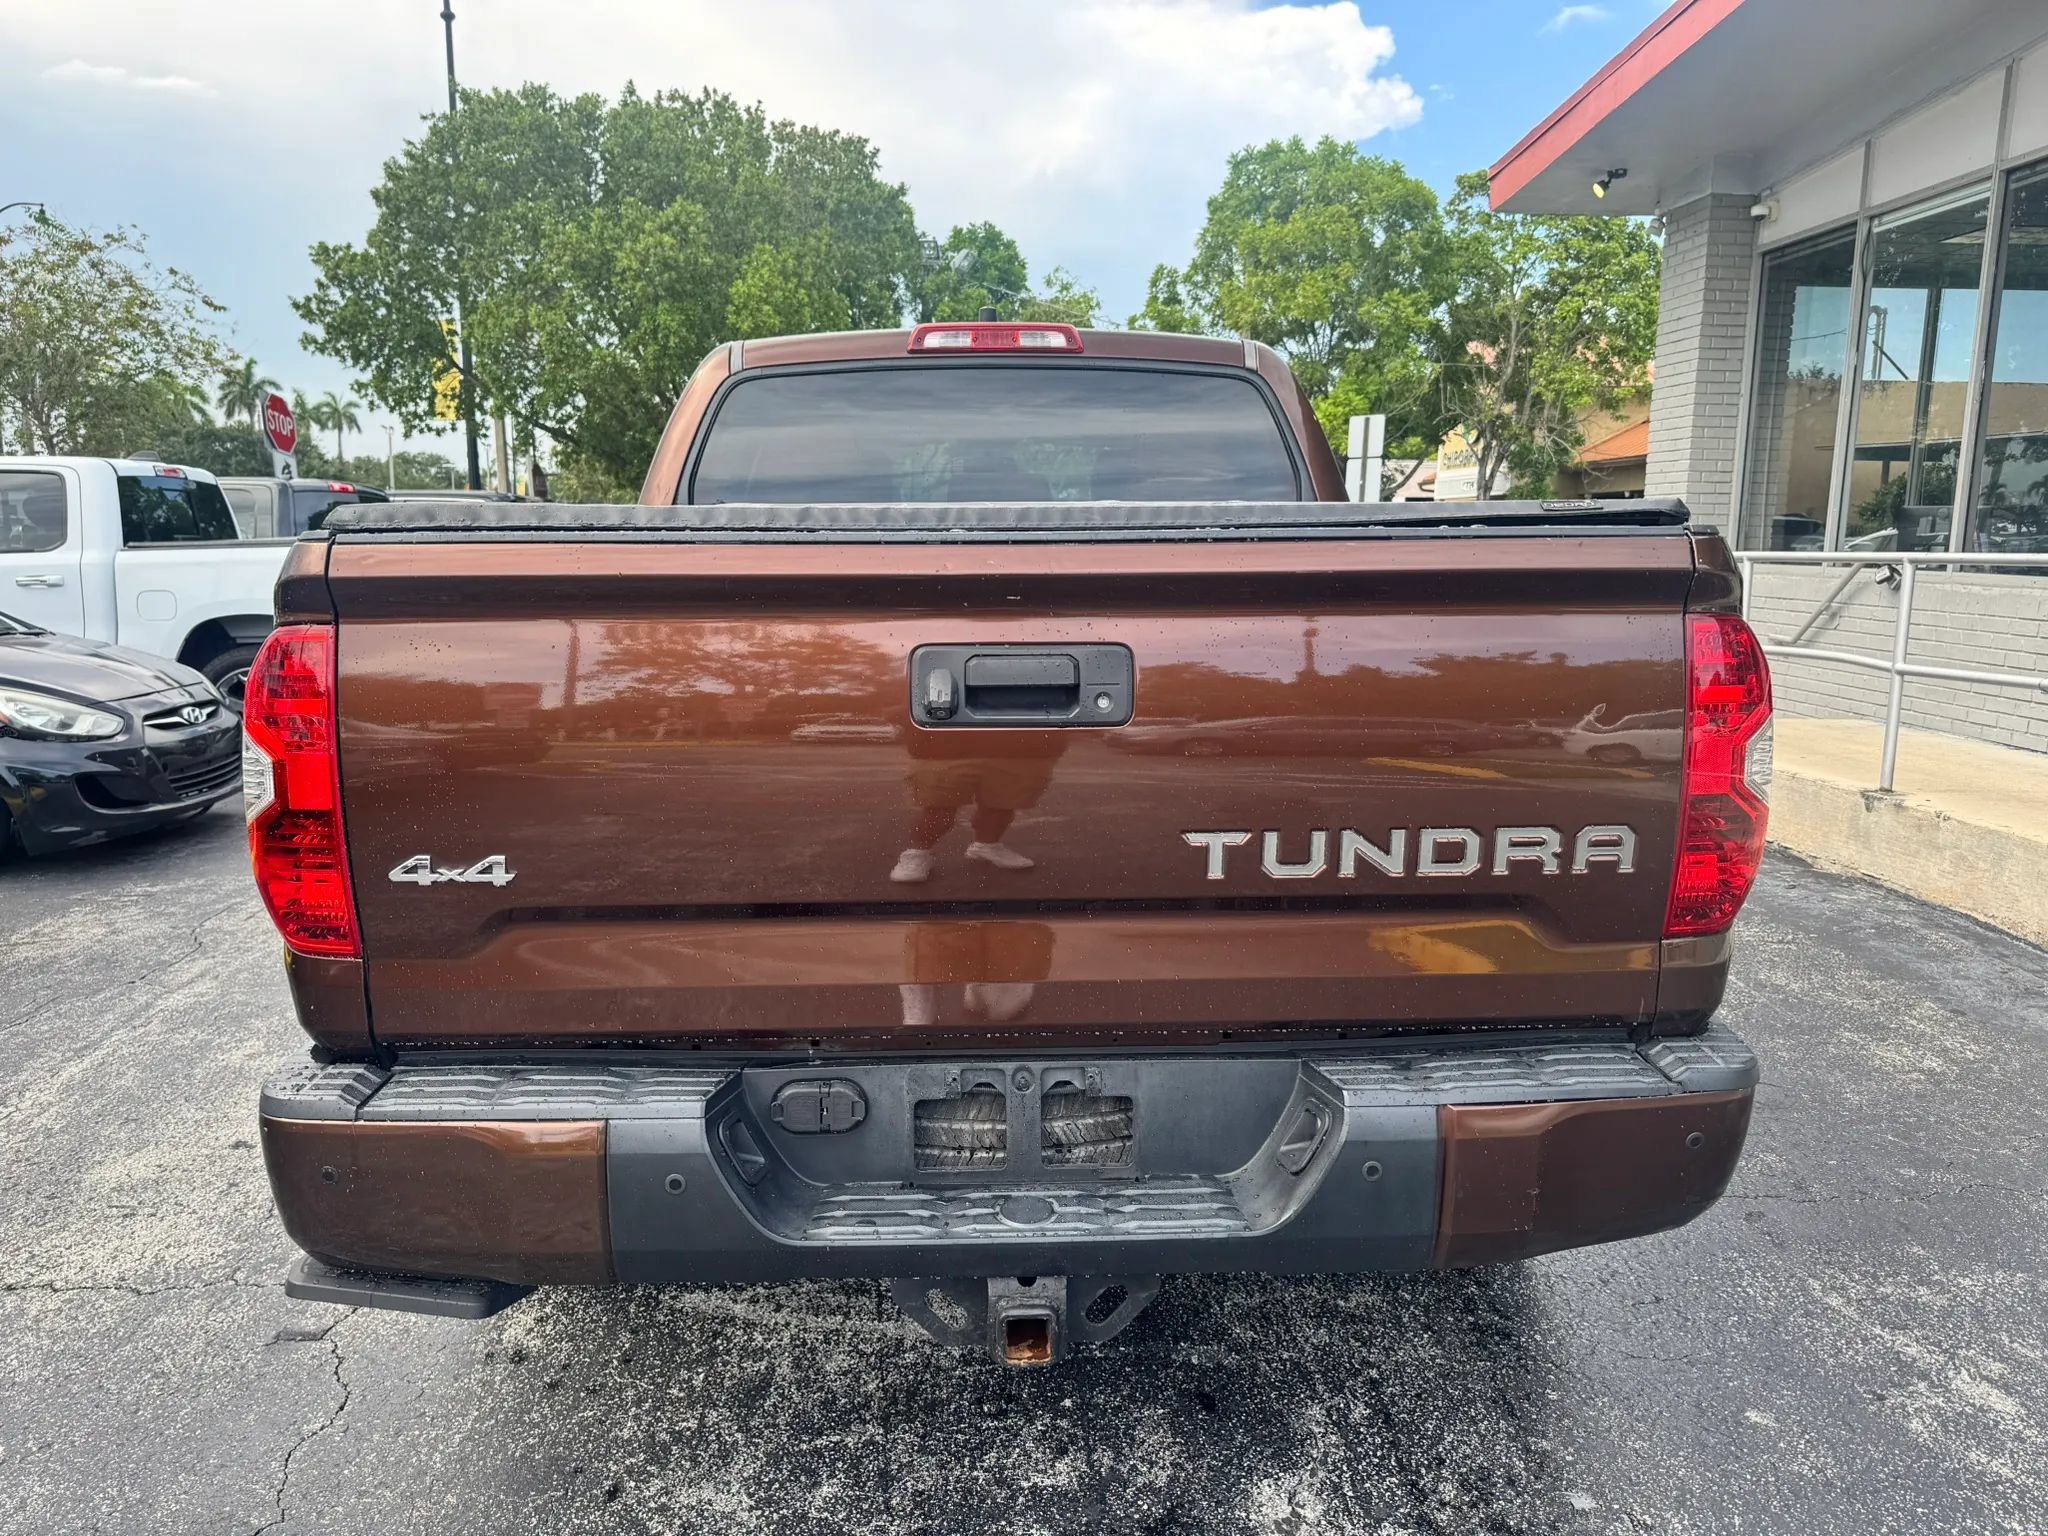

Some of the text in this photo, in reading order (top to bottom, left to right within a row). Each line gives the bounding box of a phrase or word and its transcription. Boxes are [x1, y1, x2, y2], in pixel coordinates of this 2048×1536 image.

[267, 408, 293, 437] STOP
[1182, 824, 1637, 880] TUNDRA
[388, 855, 517, 887] 4x4
